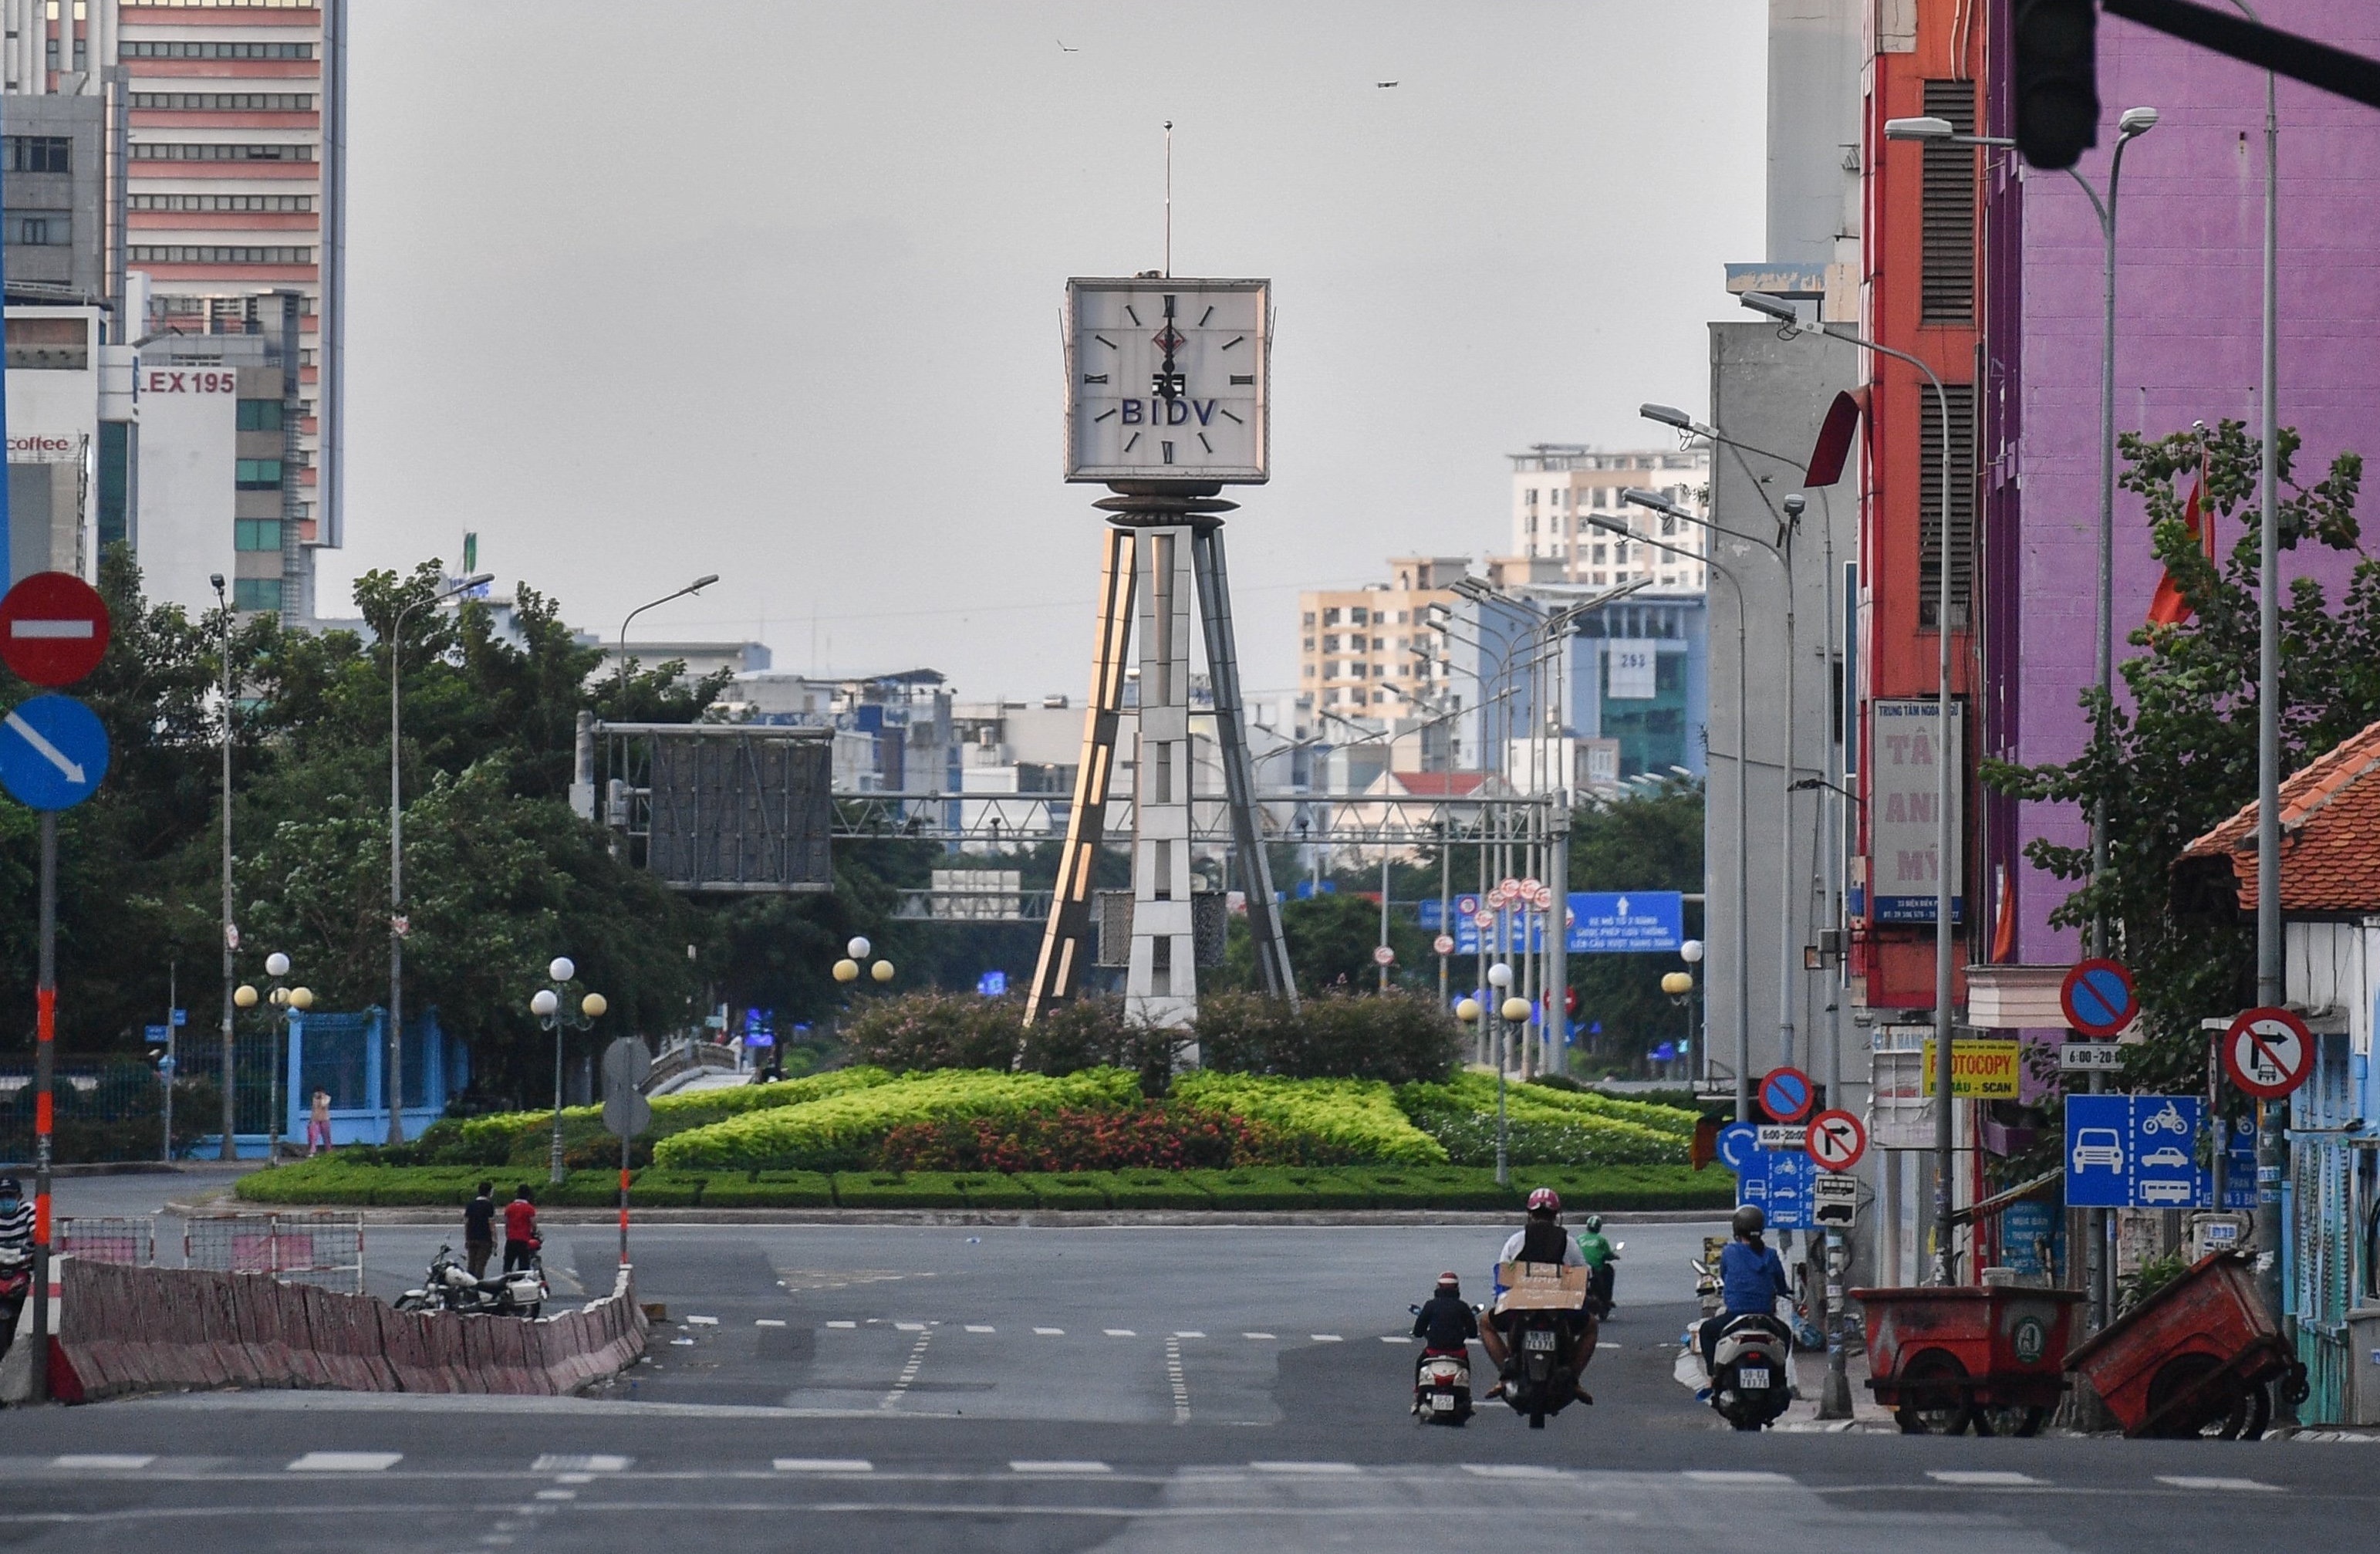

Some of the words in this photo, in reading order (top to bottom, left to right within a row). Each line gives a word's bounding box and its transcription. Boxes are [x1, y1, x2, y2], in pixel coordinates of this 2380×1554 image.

[191, 373, 234, 393] 195
[1122, 399, 1215, 425] BIDV
[1930, 1054, 2011, 1076] POTOCOPY
[1982, 1082, 2012, 1093] SCAN
